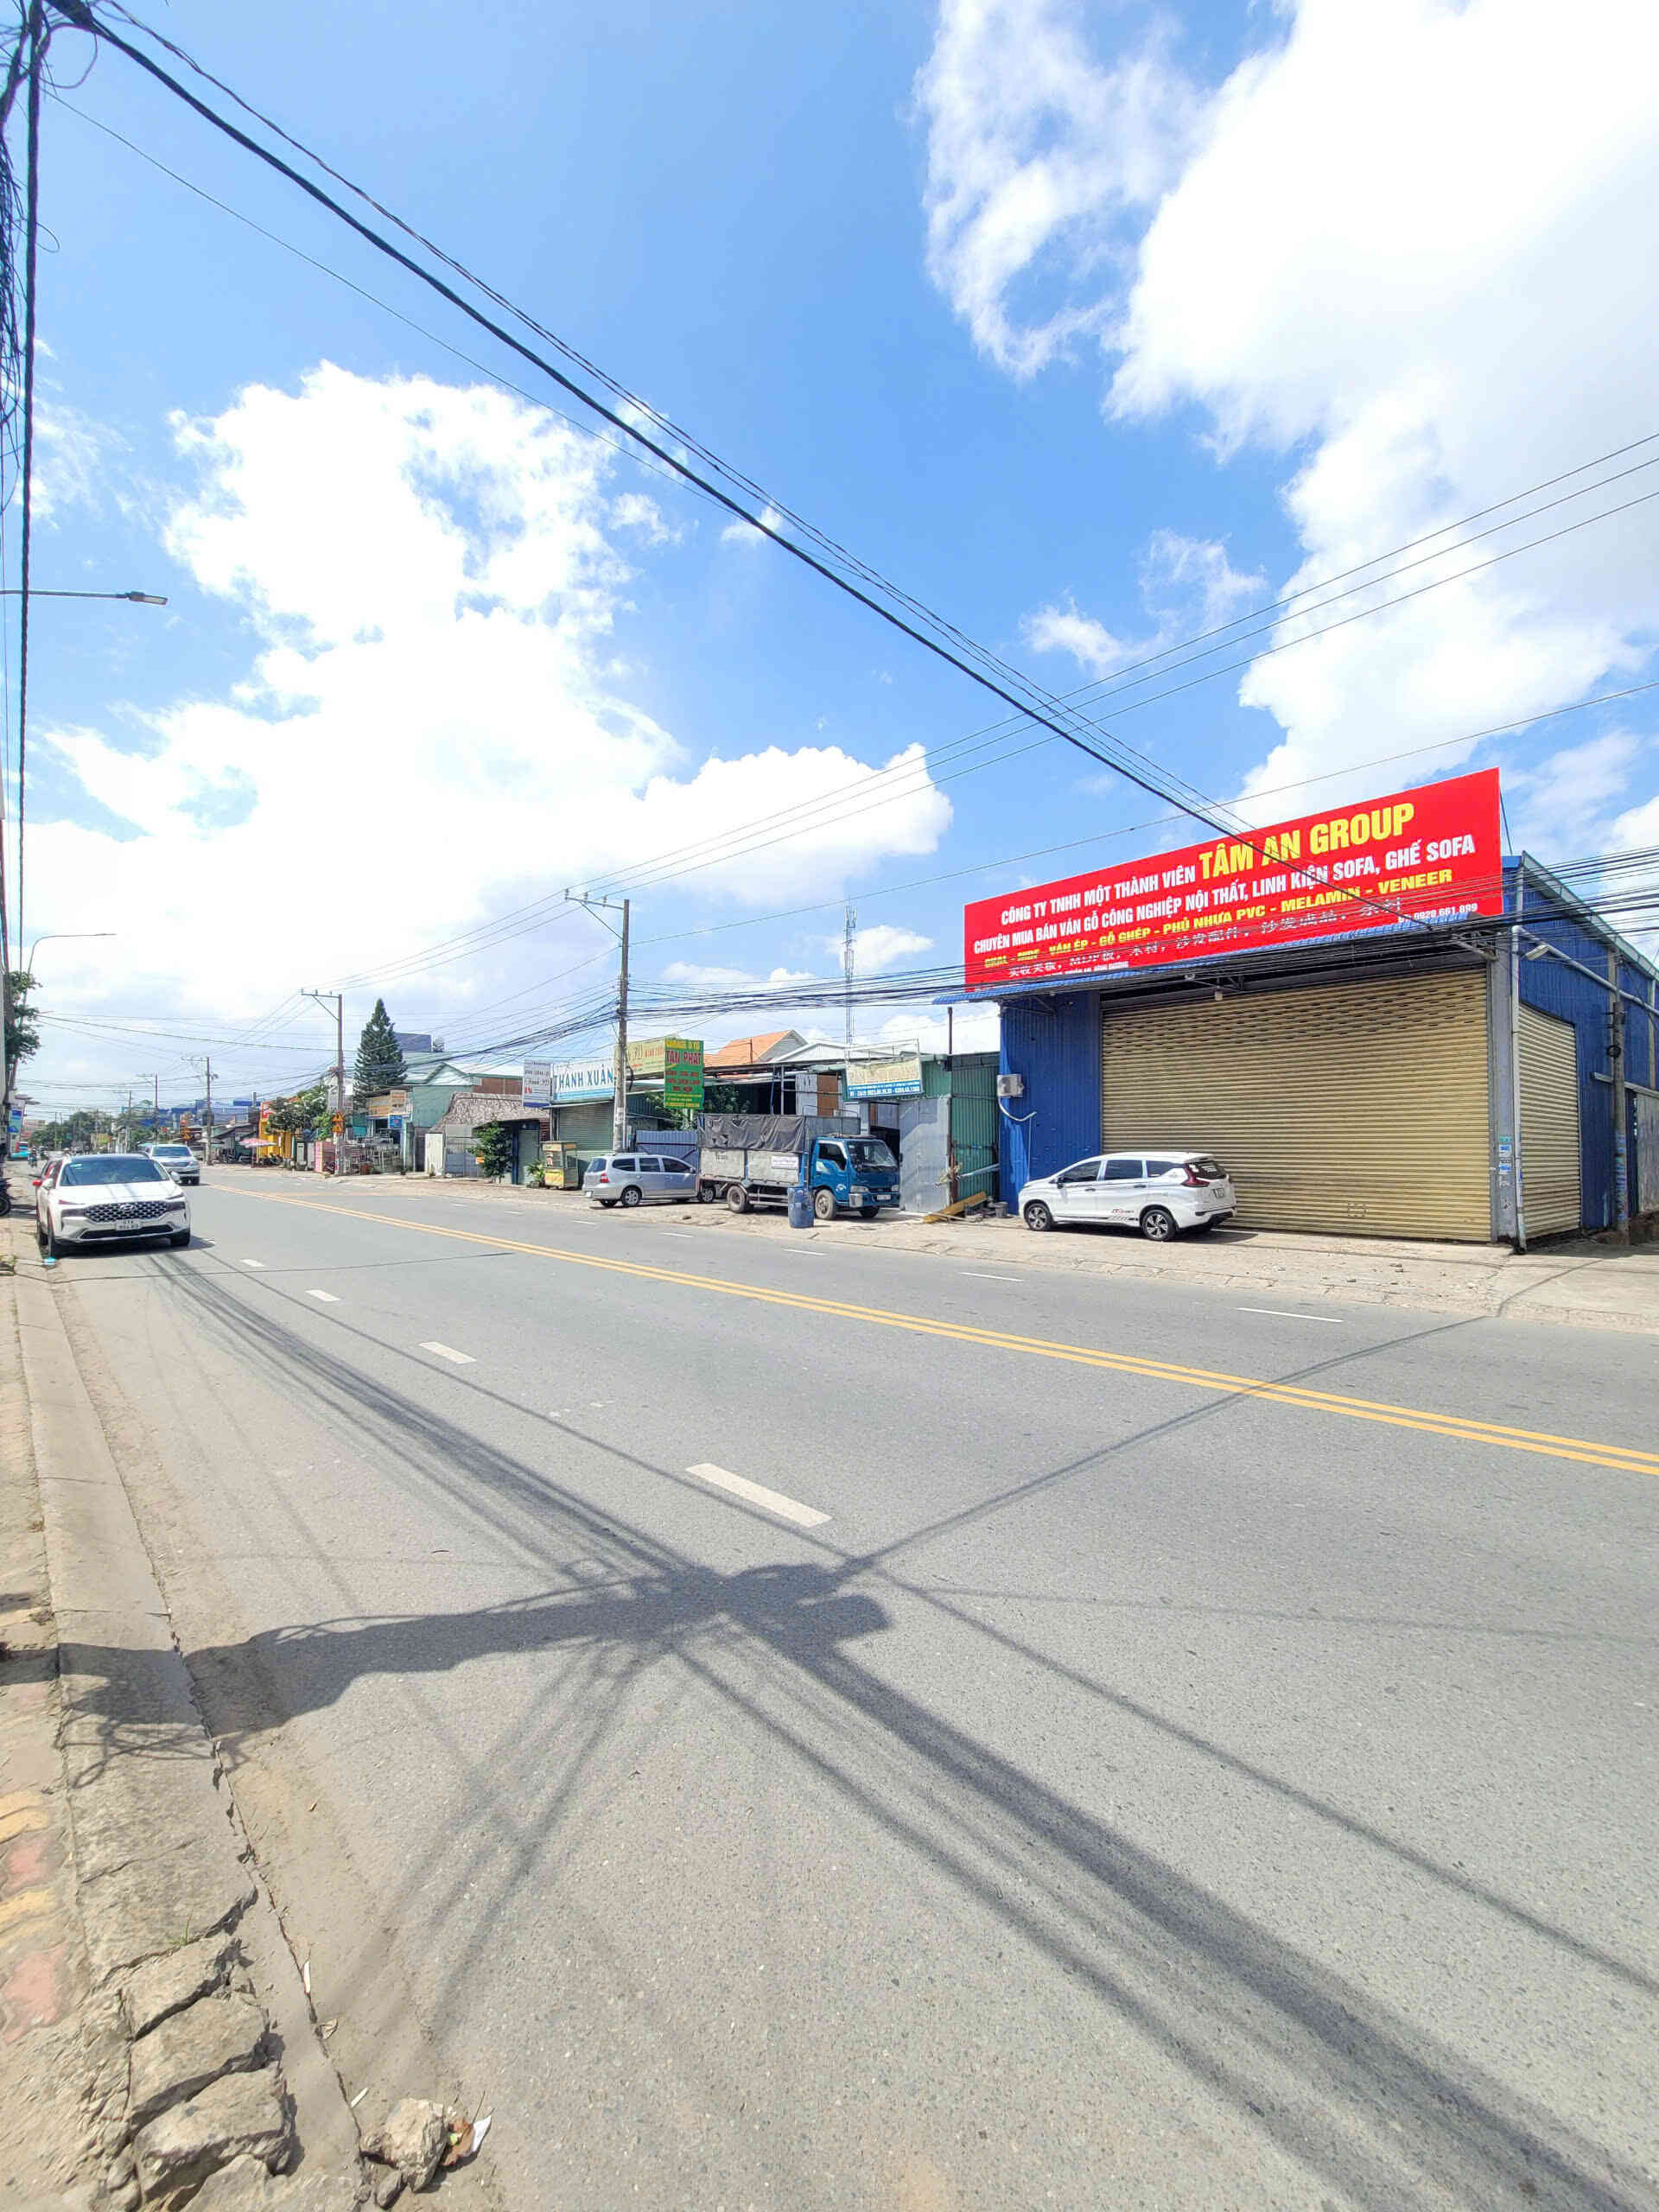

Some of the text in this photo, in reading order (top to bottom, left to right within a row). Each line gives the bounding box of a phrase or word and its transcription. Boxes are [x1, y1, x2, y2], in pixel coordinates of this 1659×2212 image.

[974, 834, 1476, 955] CHUYÊN MUA BÁN VÁN GỖ CÔNG NGHIỆP NỘI THẤT, LINH KIỆN SOFA, GHẾ SOFA
[1001, 803, 1414, 925] CÔNG TY TNHH MỘT THÀNH VIÊN TÂM AN GROUP
[1118, 926, 1151, 944] GHÉP
[1163, 917, 1190, 935] PHỦ
[1193, 912, 1233, 929] NHỰA
[1236, 905, 1266, 921] PVC
[1281, 887, 1361, 912] MELAMIN
[1378, 868, 1452, 894] VENEER
